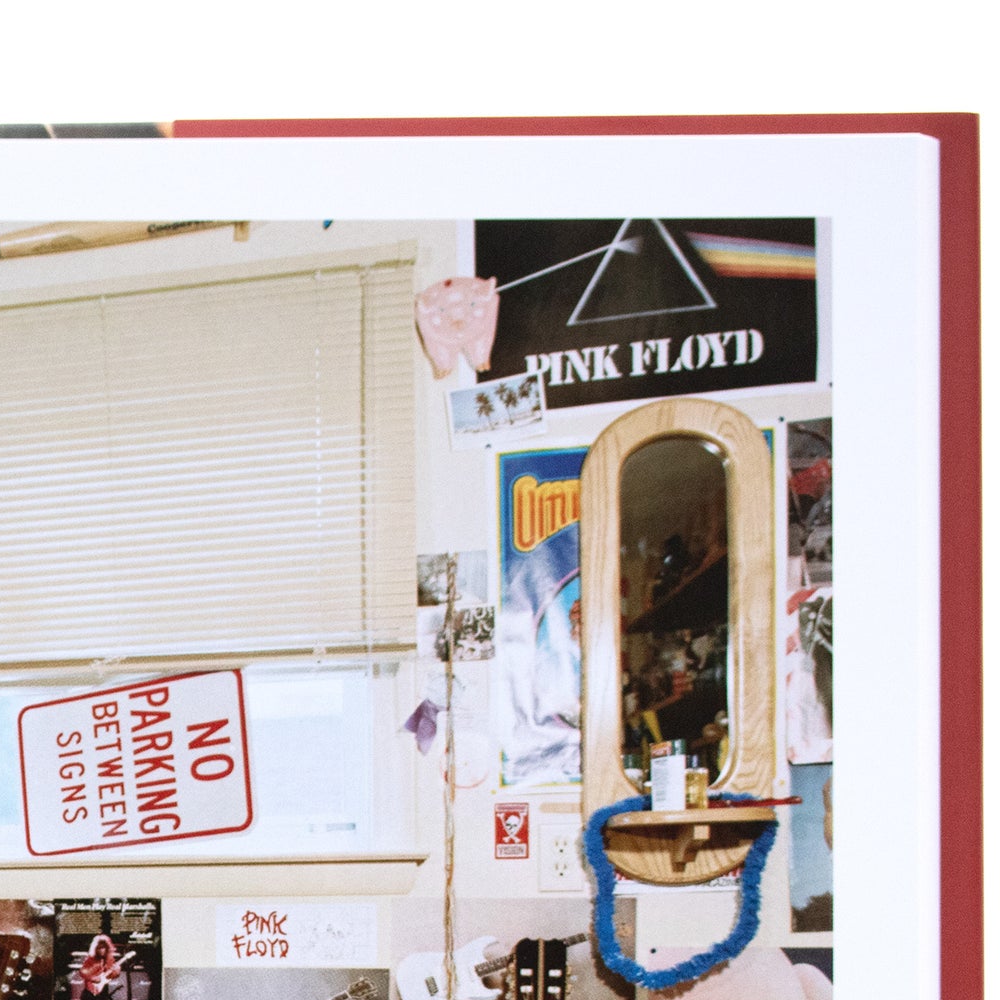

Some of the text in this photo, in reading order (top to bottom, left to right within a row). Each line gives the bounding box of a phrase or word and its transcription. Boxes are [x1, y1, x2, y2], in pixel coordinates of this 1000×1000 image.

[524, 328, 764, 387] PINK FLOYD
[56, 731, 88, 824] SIGNS
[91, 701, 128, 838] BETWEEN
[128, 686, 181, 835] PARKING
[186, 718, 235, 782] NO
[231, 934, 289, 959] FLOYD
[241, 910, 287, 936] PINK
